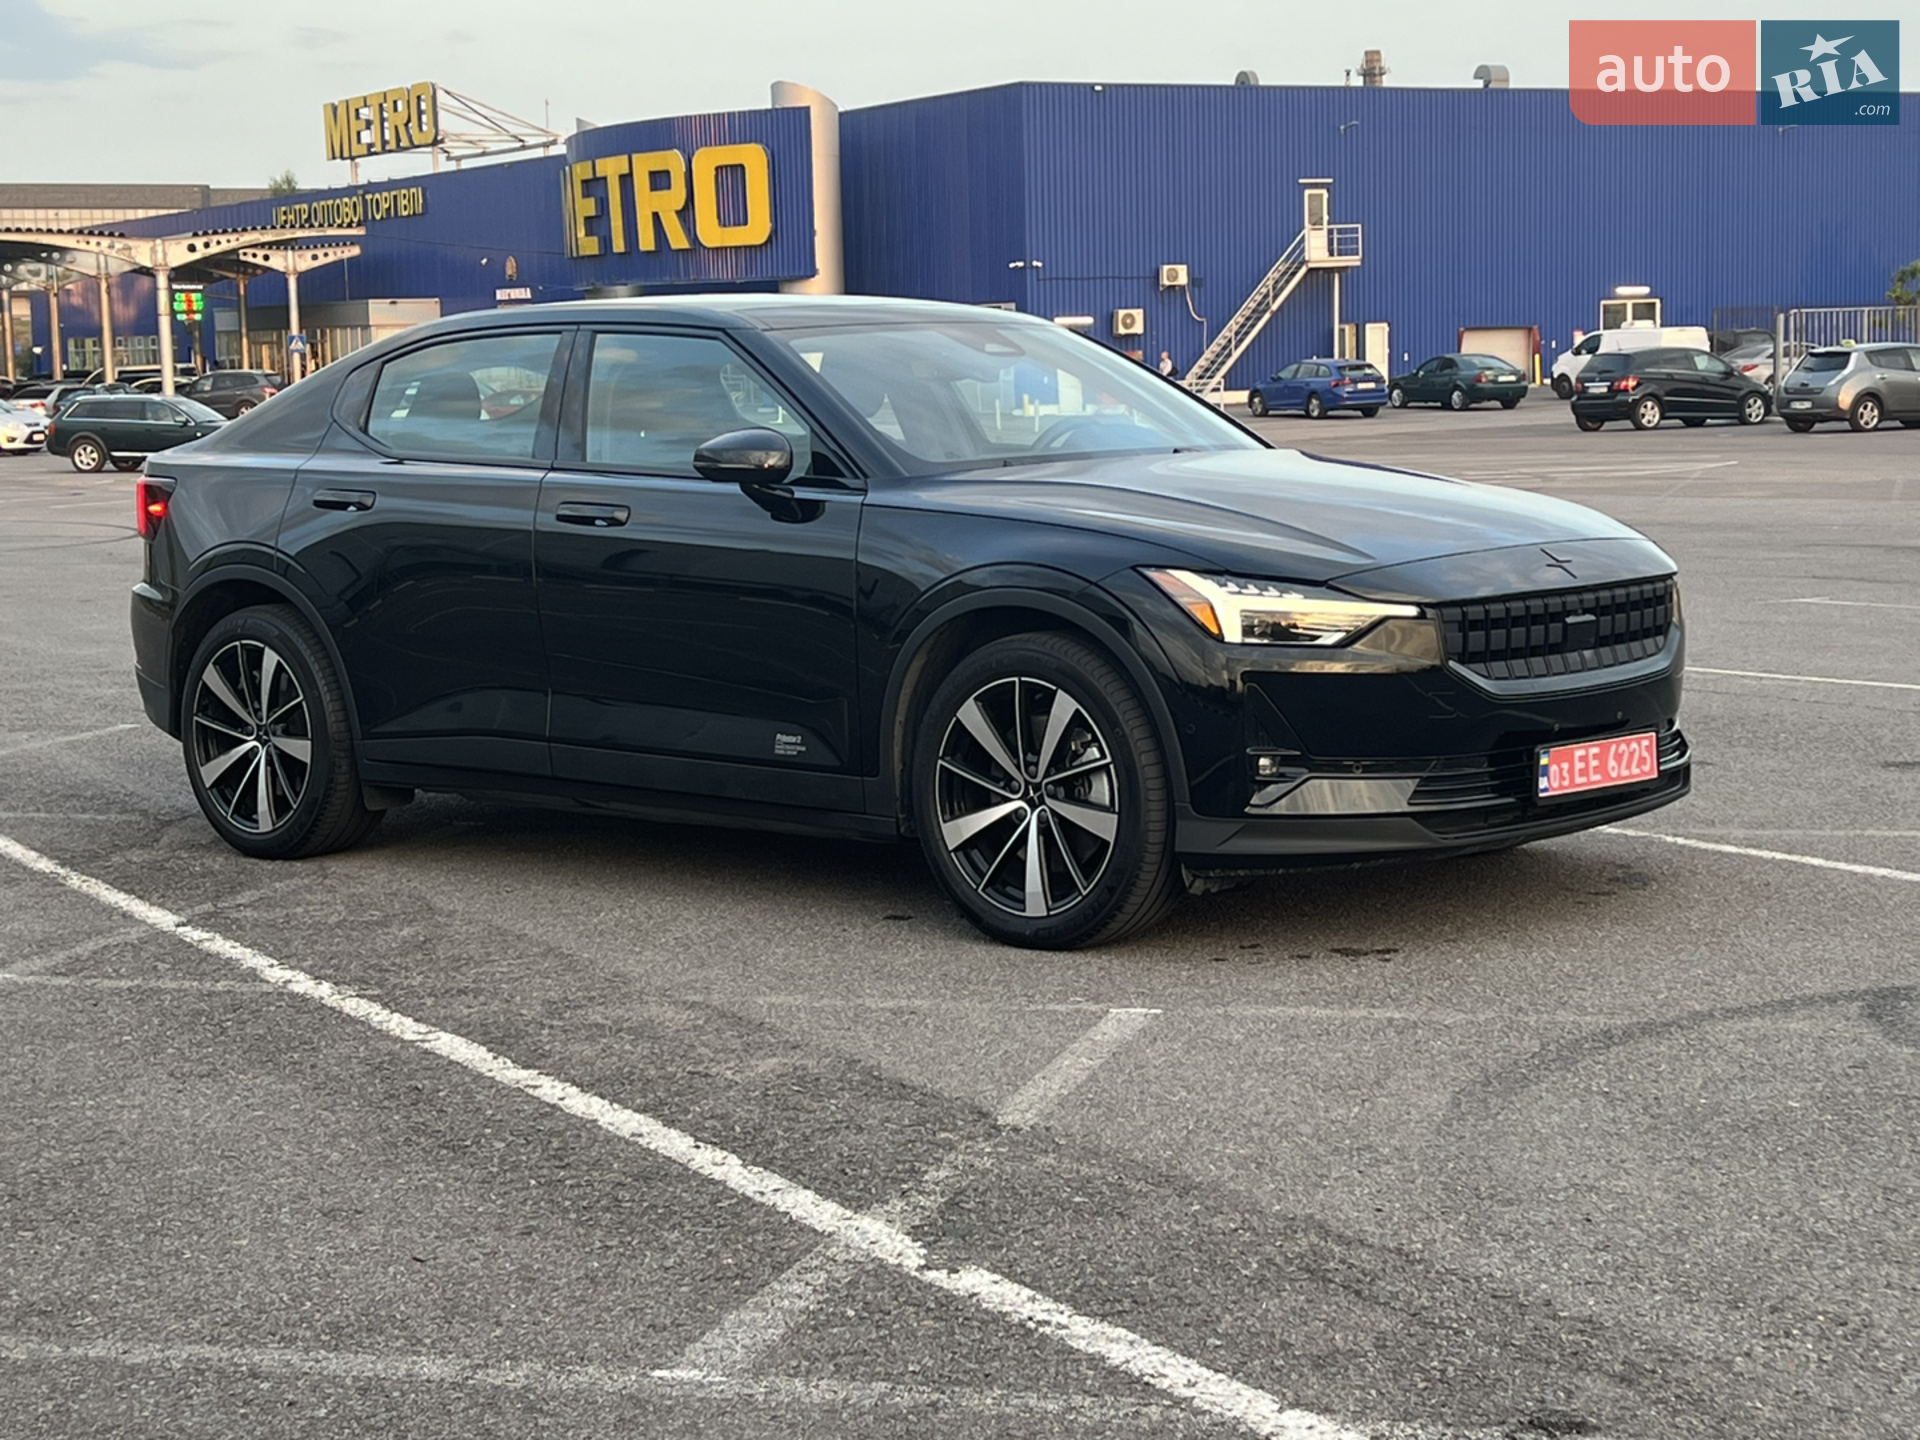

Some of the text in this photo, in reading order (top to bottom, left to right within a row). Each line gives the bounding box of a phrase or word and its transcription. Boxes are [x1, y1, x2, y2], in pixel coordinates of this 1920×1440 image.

[323, 81, 437, 160] METRO
[311, 189, 364, 225] ОПТОВОЇ
[365, 186, 424, 221] ТОРГІВЛІ
[560, 143, 772, 259] METRO
[1550, 739, 1650, 789] 03 EE 6225
